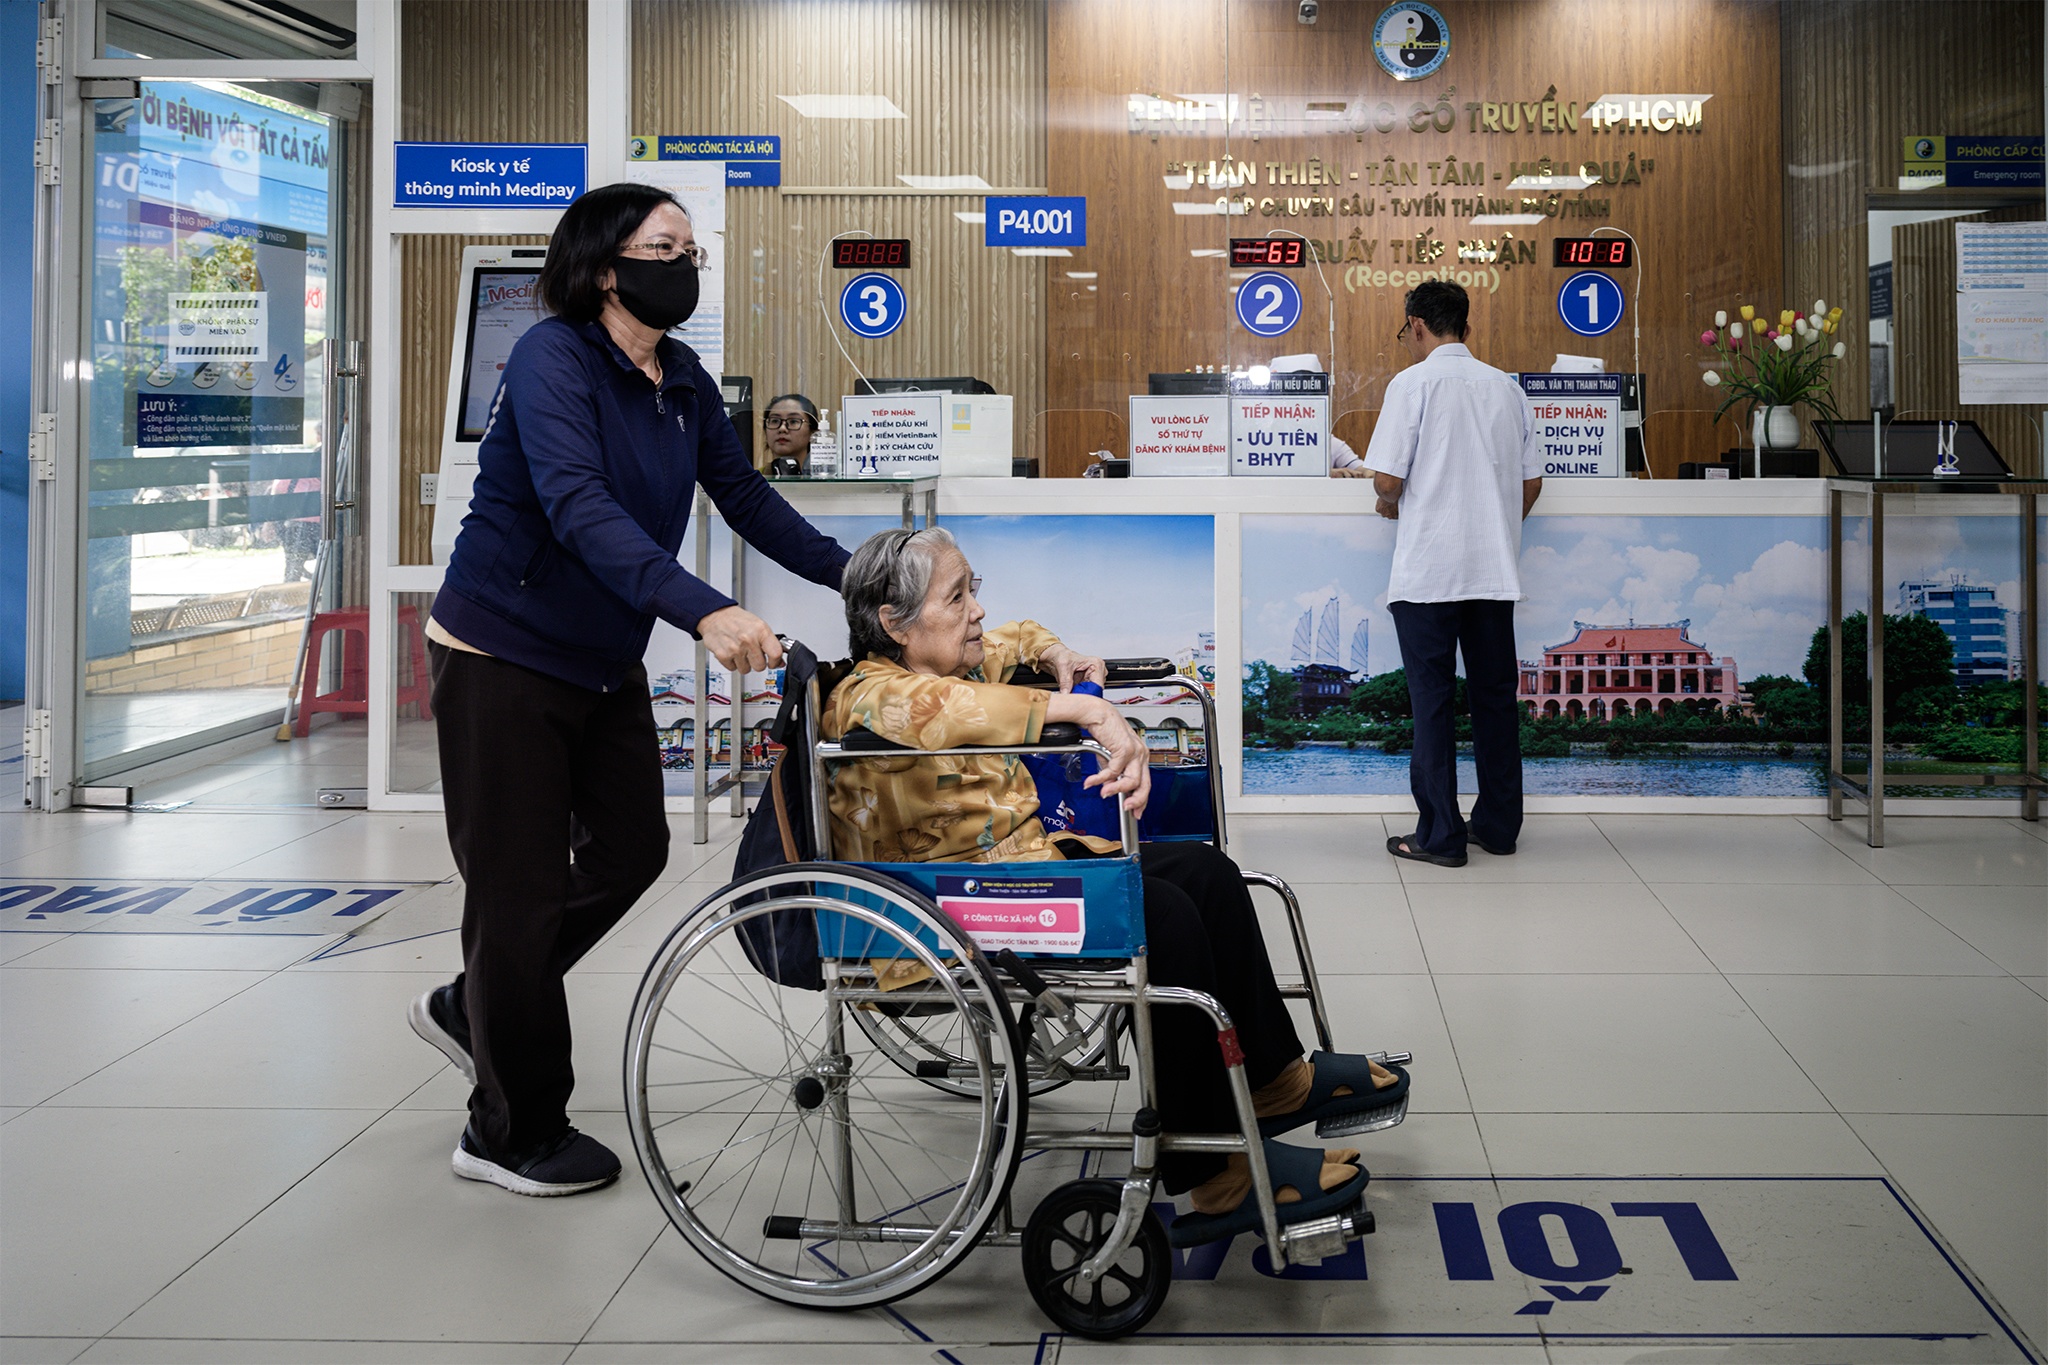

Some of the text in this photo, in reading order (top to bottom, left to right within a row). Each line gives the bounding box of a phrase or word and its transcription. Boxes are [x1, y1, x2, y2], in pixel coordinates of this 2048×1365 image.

[1407, 85, 1456, 133] CỔ
[1465, 84, 1578, 133] TRUYỀN
[166, 97, 212, 142] BỆNH
[216, 113, 247, 148] VỚI
[249, 119, 277, 157] TẤT
[281, 127, 299, 163] CẢ
[665, 140, 774, 156] PHÒNG CÔNG TÁC XÃ HỘI
[1957, 144, 2000, 157] PHÒNG
[2003, 143, 2029, 157] CẤP
[451, 157, 531, 176] Kiosk y tế
[1266, 154, 1341, 193] THIỆN
[1365, 155, 1418, 193] TẬN
[1427, 154, 1484, 186] TÂM
[728, 170, 751, 179] Room
[1974, 171, 2018, 180] Emergency
[405, 181, 576, 199] thông minh Medipay
[1339, 193, 1375, 216] SÂU
[1391, 191, 1446, 217] TUYẾN
[1451, 192, 1514, 217] THÀNH
[999, 209, 1073, 235] P4.001
[265, 232, 287, 243] VNEID
[1306, 226, 1537, 271] QUẦY TIẾP NHẬN
[859, 285, 888, 327] 3
[1254, 284, 1284, 325] 2
[1579, 283, 1598, 325] 1
[1564, 380, 1575, 392] THỊ
[1576, 380, 1598, 390] THANH
[1600, 378, 1617, 390] THẢO
[872, 408, 916, 418] TIẾP NHẬN:
[1151, 414, 1210, 424] VUI LÒNG LẤY
[1242, 402, 1316, 422] TIẾP NHẬN:
[1533, 402, 1607, 422] TIẾP NHẬN:
[914, 419, 928, 427] KHÍ
[1158, 429, 1203, 440] SỐ THỨ TỰ
[1248, 428, 1318, 446] ƯU TIÊN
[1545, 426, 1604, 441] DỊCH VỤ
[880, 442, 890, 450] KÝ
[917, 441, 934, 450] CỨU
[1135, 444, 1226, 455] ĐĂNG KÝ KHÁM BỆNH
[1545, 441, 1603, 456] THU PHÍ
[880, 454, 890, 462] KÝ
[908, 454, 939, 462] NGHIỆM
[1248, 452, 1295, 466] BHYT
[1545, 462, 1598, 474] ONLINE
[963, 913, 1054, 924] P. CÔNG TÁC XÃ HỘI 16
